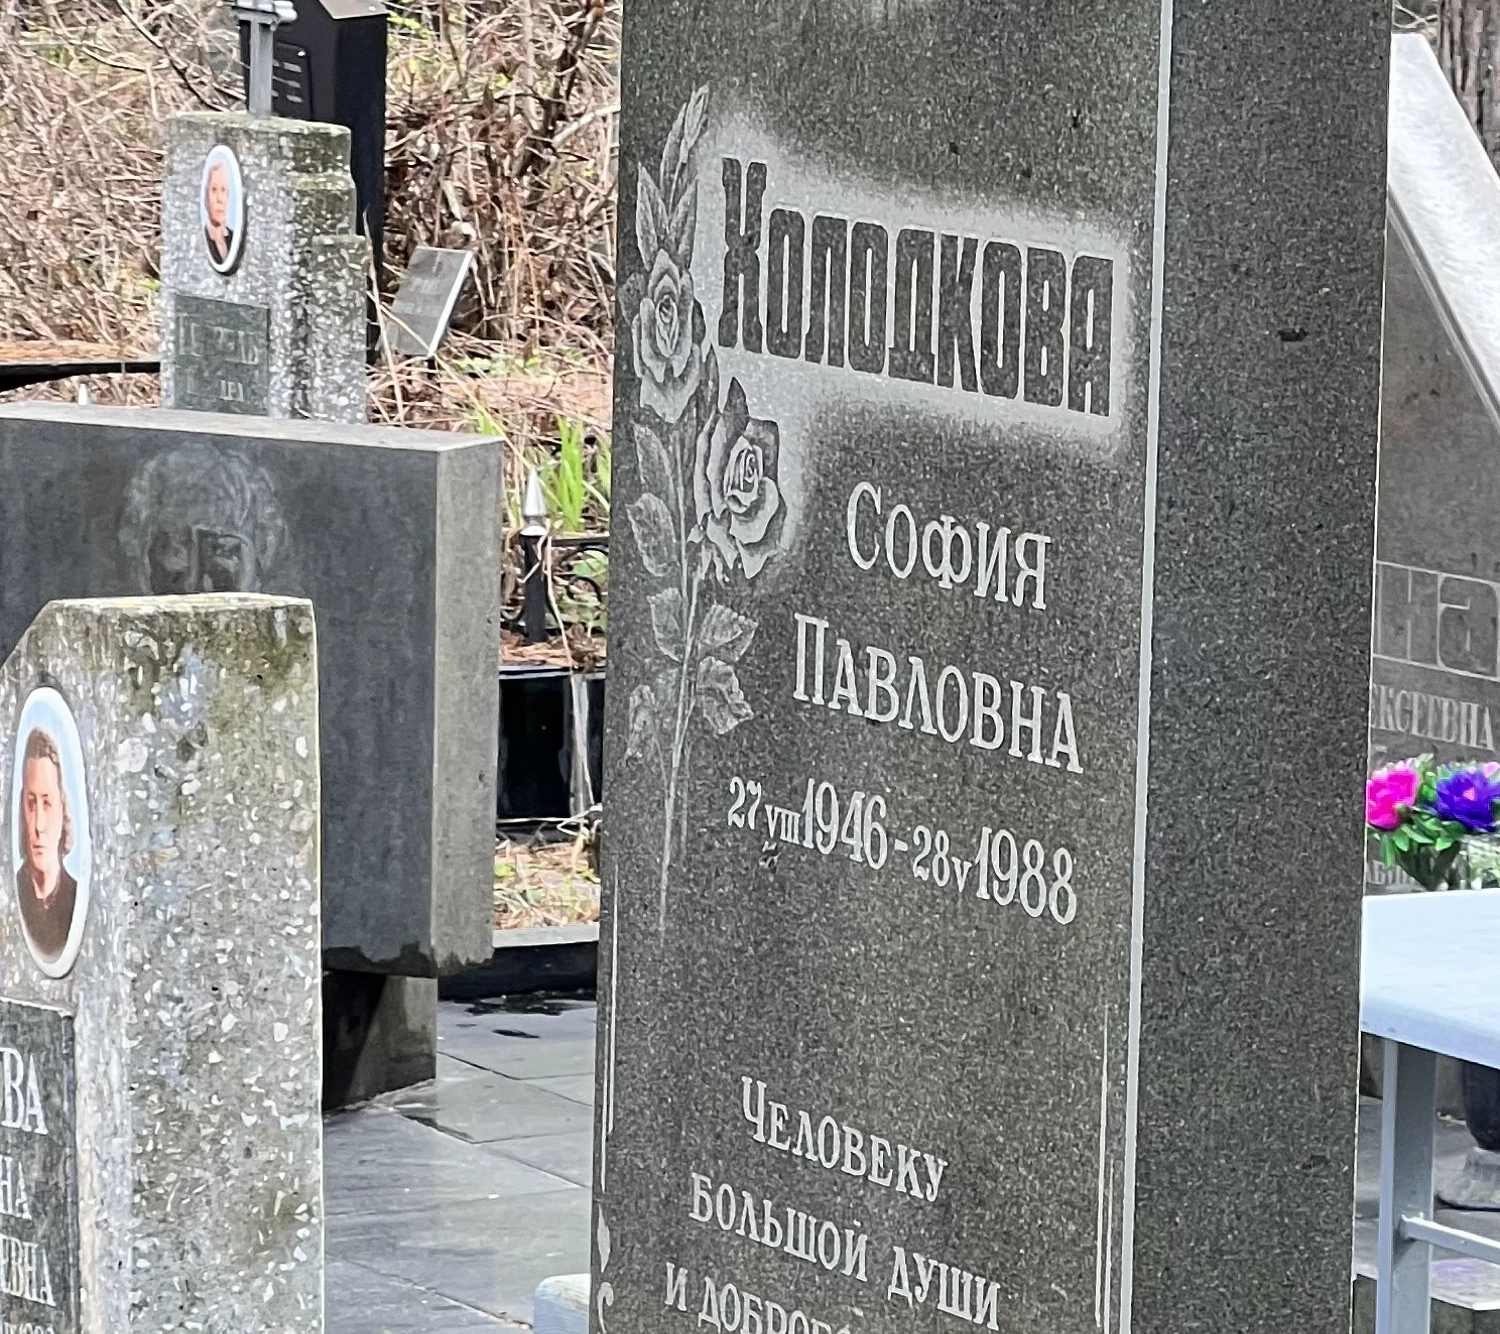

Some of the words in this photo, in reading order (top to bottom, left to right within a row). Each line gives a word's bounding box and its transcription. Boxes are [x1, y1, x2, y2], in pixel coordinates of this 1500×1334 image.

[846, 481, 1052, 611] СОФИЯ
[792, 612, 1084, 774] ПАВЛОВНА
[0, 1047, 48, 1135] ВА
[740, 1075, 948, 1203] ЧЕЛОВЕКУ
[664, 1261, 689, 1311] И
[688, 1171, 868, 1282] БОЛЬШОЙ
[888, 1245, 1001, 1331] ДУШИ
